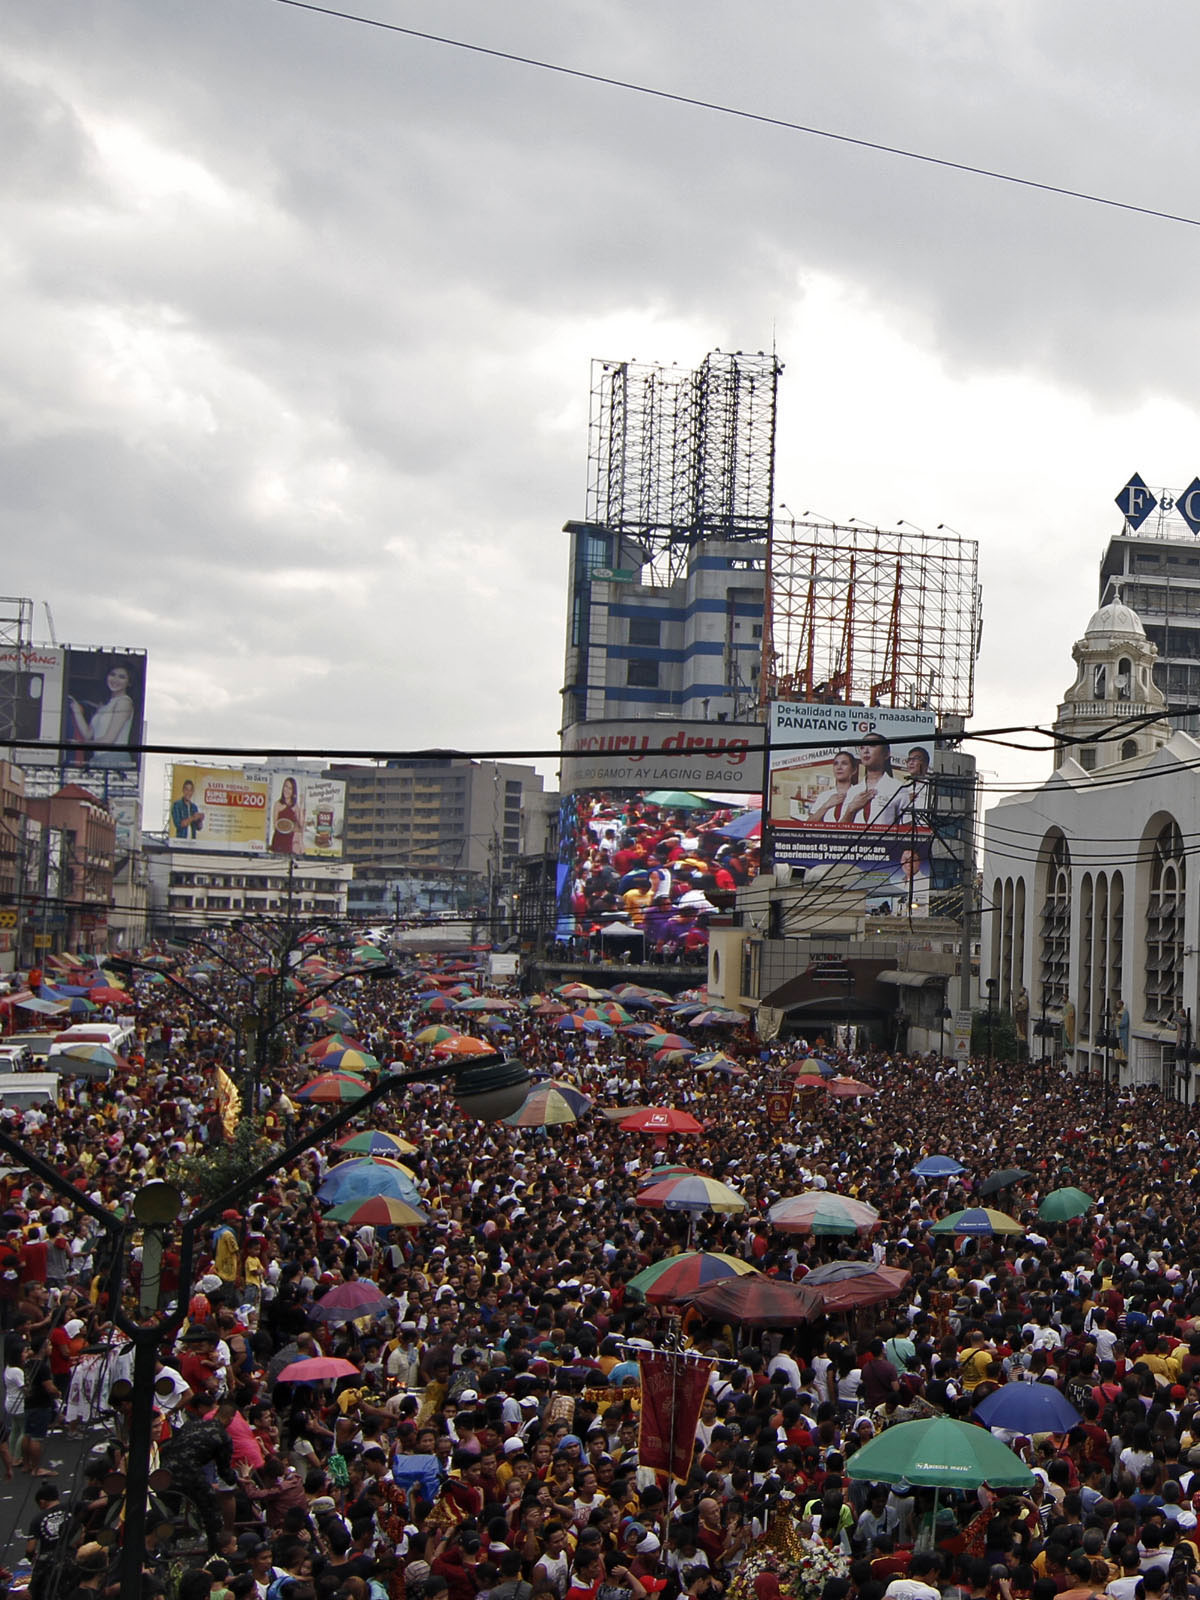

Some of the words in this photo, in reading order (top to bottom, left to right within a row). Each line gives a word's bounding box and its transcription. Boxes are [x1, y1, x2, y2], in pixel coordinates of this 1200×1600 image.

[777, 704, 832, 717] De-kalidad
[834, 709, 846, 718] na
[848, 708, 877, 720] lunas,
[879, 711, 933, 724] maaasahan
[777, 716, 848, 731] PANATANG
[851, 720, 876, 733] TGP
[660, 731, 749, 765] drug
[598, 768, 633, 779] GAMOT
[634, 768, 650, 779] AY
[652, 769, 701, 780] LAGING
[705, 770, 743, 782] BAGO
[230, 793, 265, 807] TU200
[775, 842, 791, 850] Men
[792, 842, 818, 851] almost
[818, 843, 829, 851] 45
[774, 851, 823, 860] experiencing
